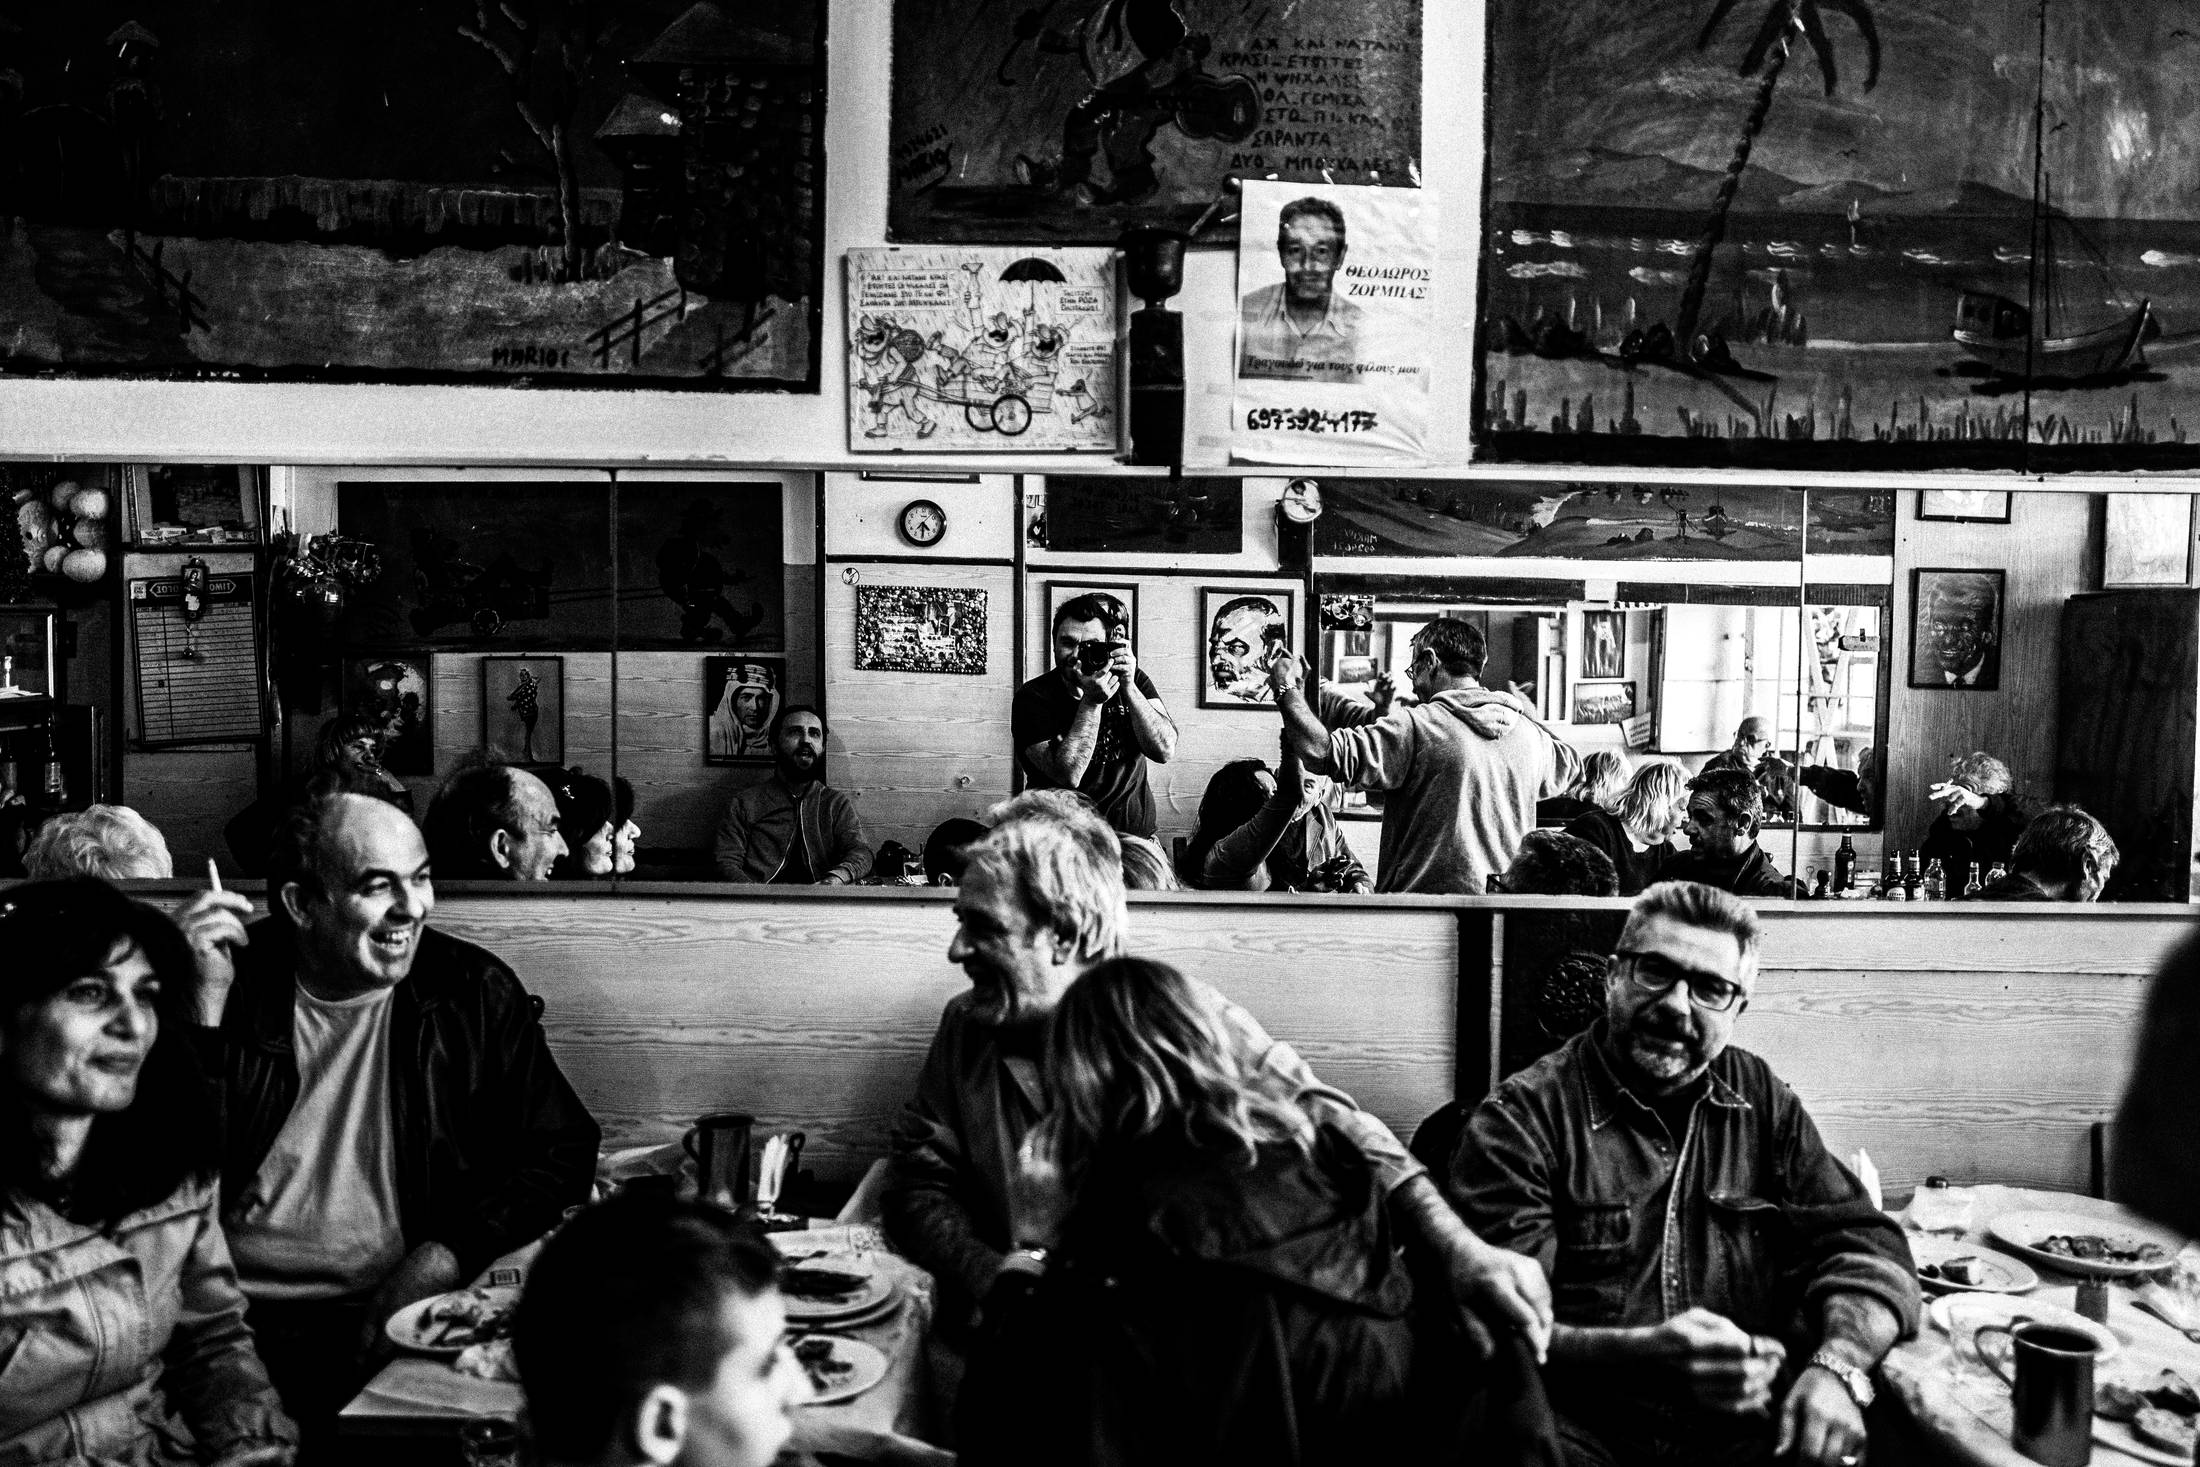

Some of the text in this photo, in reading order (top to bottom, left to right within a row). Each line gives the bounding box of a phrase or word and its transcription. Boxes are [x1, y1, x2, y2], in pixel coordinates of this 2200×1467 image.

[1219, 51, 1268, 68] ΚΡΑΣΙ
[1250, 129, 1332, 149] ΣΑΡΑΝΤΑ
[1230, 152, 1264, 169] ΔΥΟ
[1345, 264, 1432, 281] ΘΕΟΔΩΡΟΣ
[1348, 283, 1427, 299] ΖΟΡΜΠΑΣ
[1306, 361, 1325, 372] για
[1328, 361, 1354, 375] τους
[1356, 361, 1396, 376] φίλους
[1397, 365, 1421, 376] μου
